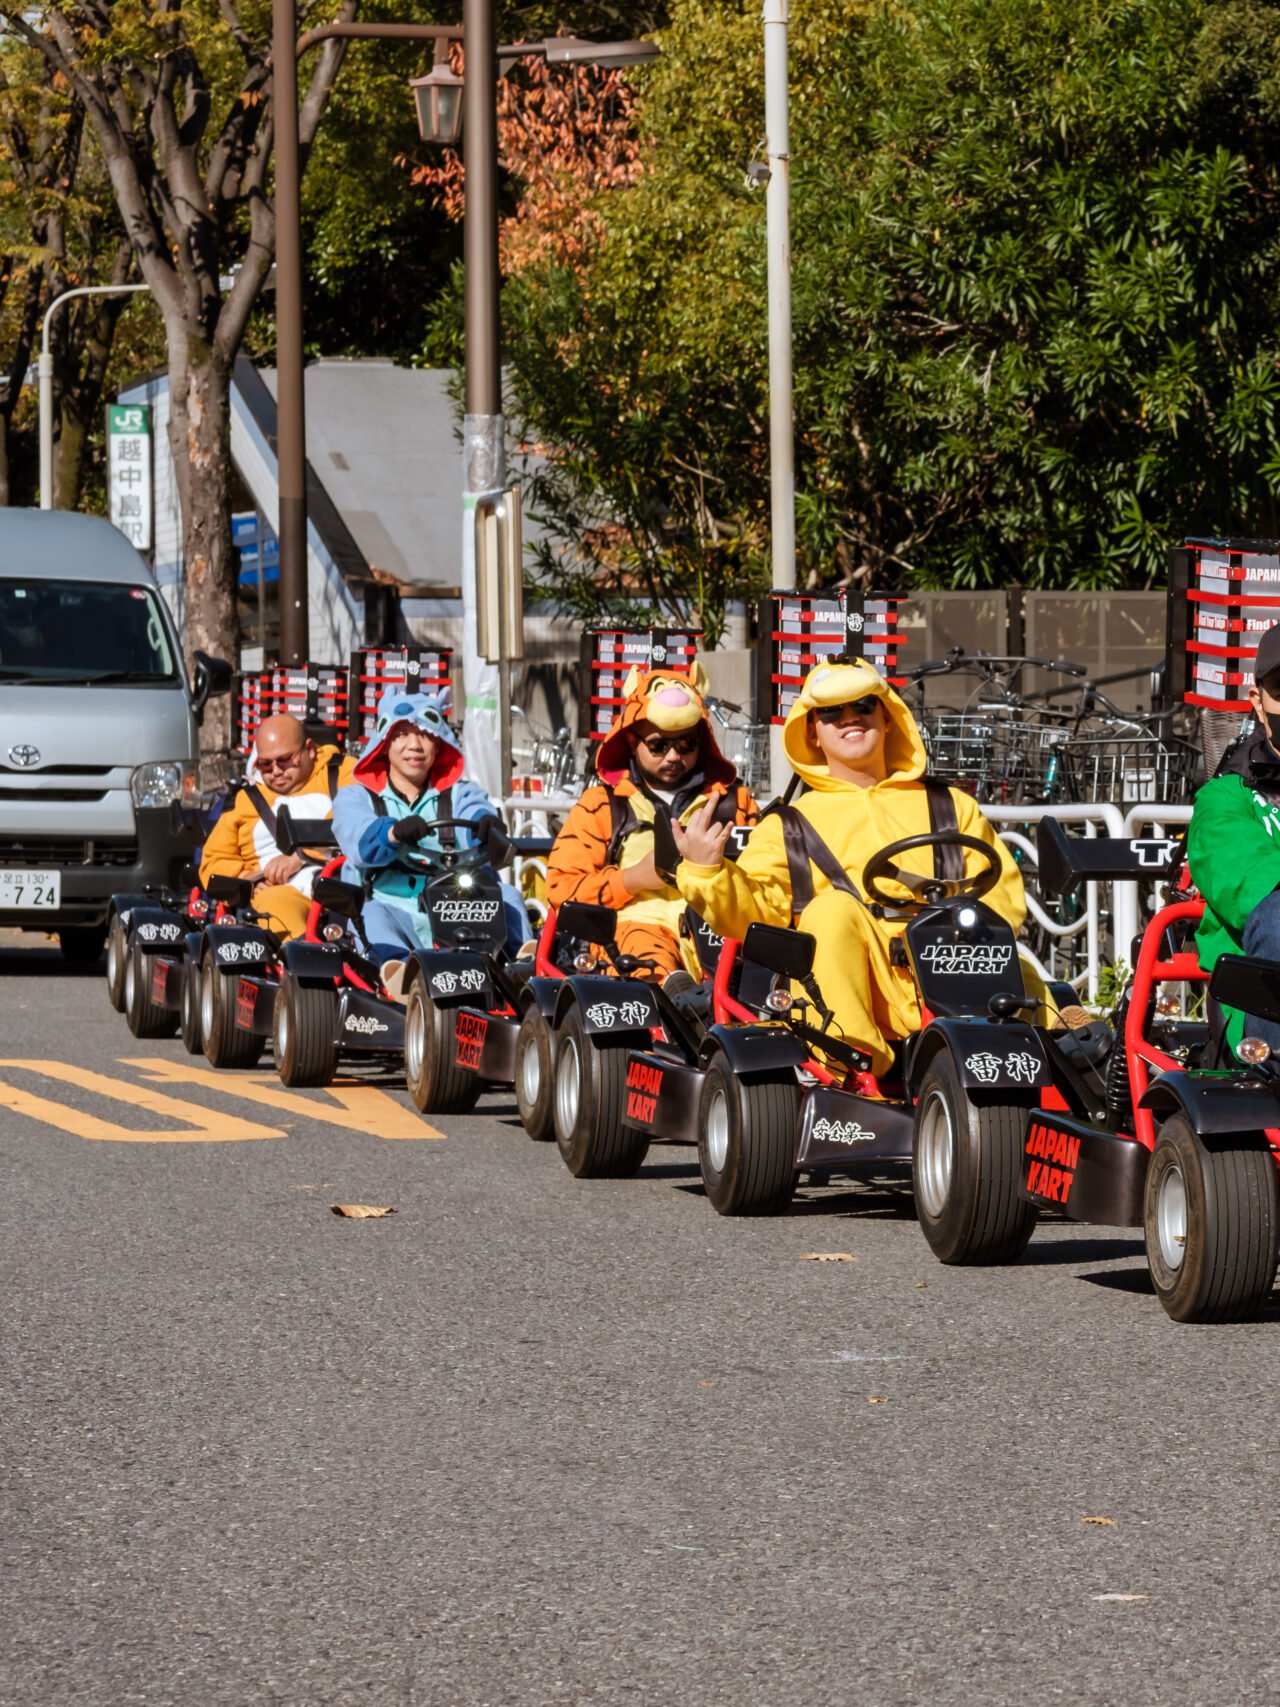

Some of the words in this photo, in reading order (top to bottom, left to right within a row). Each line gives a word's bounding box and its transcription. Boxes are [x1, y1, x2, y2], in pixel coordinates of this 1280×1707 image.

[115, 409, 144, 427] JR
[432, 900, 499, 913] JAPAN
[440, 911, 496, 922] KART
[920, 945, 1012, 960] JAPAN
[932, 959, 1009, 974] KART
[455, 1013, 488, 1045] JAPAN
[586, 1001, 650, 1028] 雷神
[455, 1038, 484, 1070] KART
[965, 1052, 1041, 1084] 雷神
[626, 1061, 664, 1096] JAPAN
[626, 1091, 658, 1124] KART
[812, 1117, 876, 1145] 安全第一
[1025, 1122, 1081, 1171] JAPAN
[1026, 1163, 1074, 1204] KART
